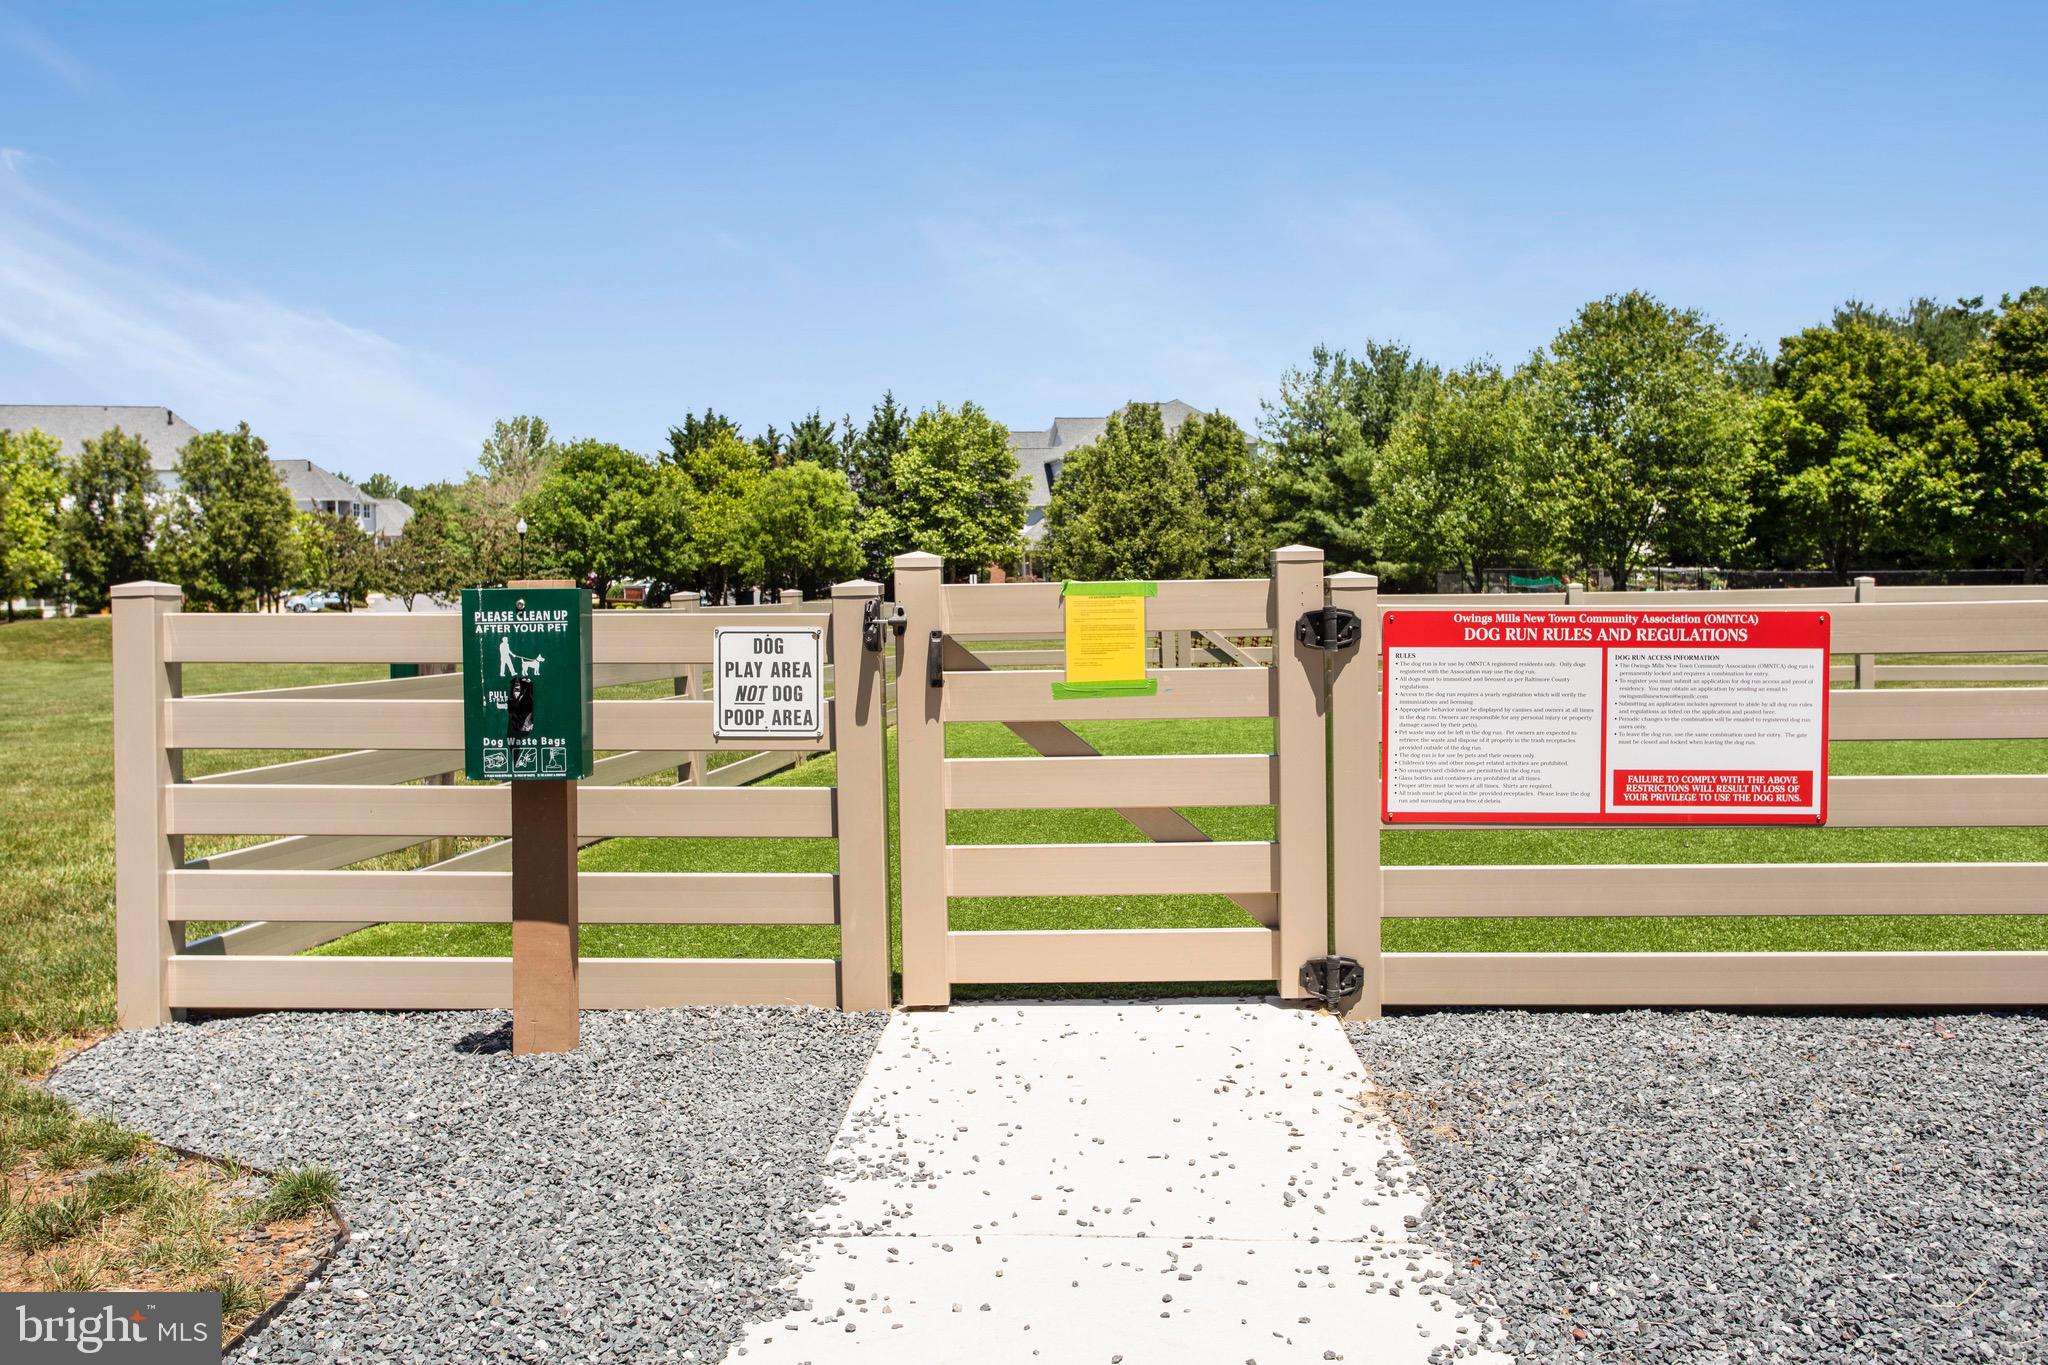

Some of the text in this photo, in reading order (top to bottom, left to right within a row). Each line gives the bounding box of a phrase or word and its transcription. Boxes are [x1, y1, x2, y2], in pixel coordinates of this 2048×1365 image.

[474, 610, 568, 622] PLEASE CLEAN UP
[1454, 613, 1759, 625] Owings Mills New Town Community Association (OMNTCA)
[475, 623, 568, 633] AFTER YOUR PET
[1464, 628, 1748, 642] DOG RUN RULES AND REGULATIONS
[754, 638, 784, 654] DOG
[725, 662, 812, 677] PLAY AREA
[735, 685, 803, 701] NOT DOG
[725, 709, 813, 726] POOP AREA
[483, 737, 566, 747] Dog Waste Bags
[1628, 775, 1799, 784] FAILURE TO COMPLY WITH THE ABOVE
[1626, 784, 1800, 793] RESTRICTIONS WILL RESULT IN LOSS OF
[1624, 793, 1802, 802] YOUR PRIVILEGE TO USE THE DOG RUNS.
